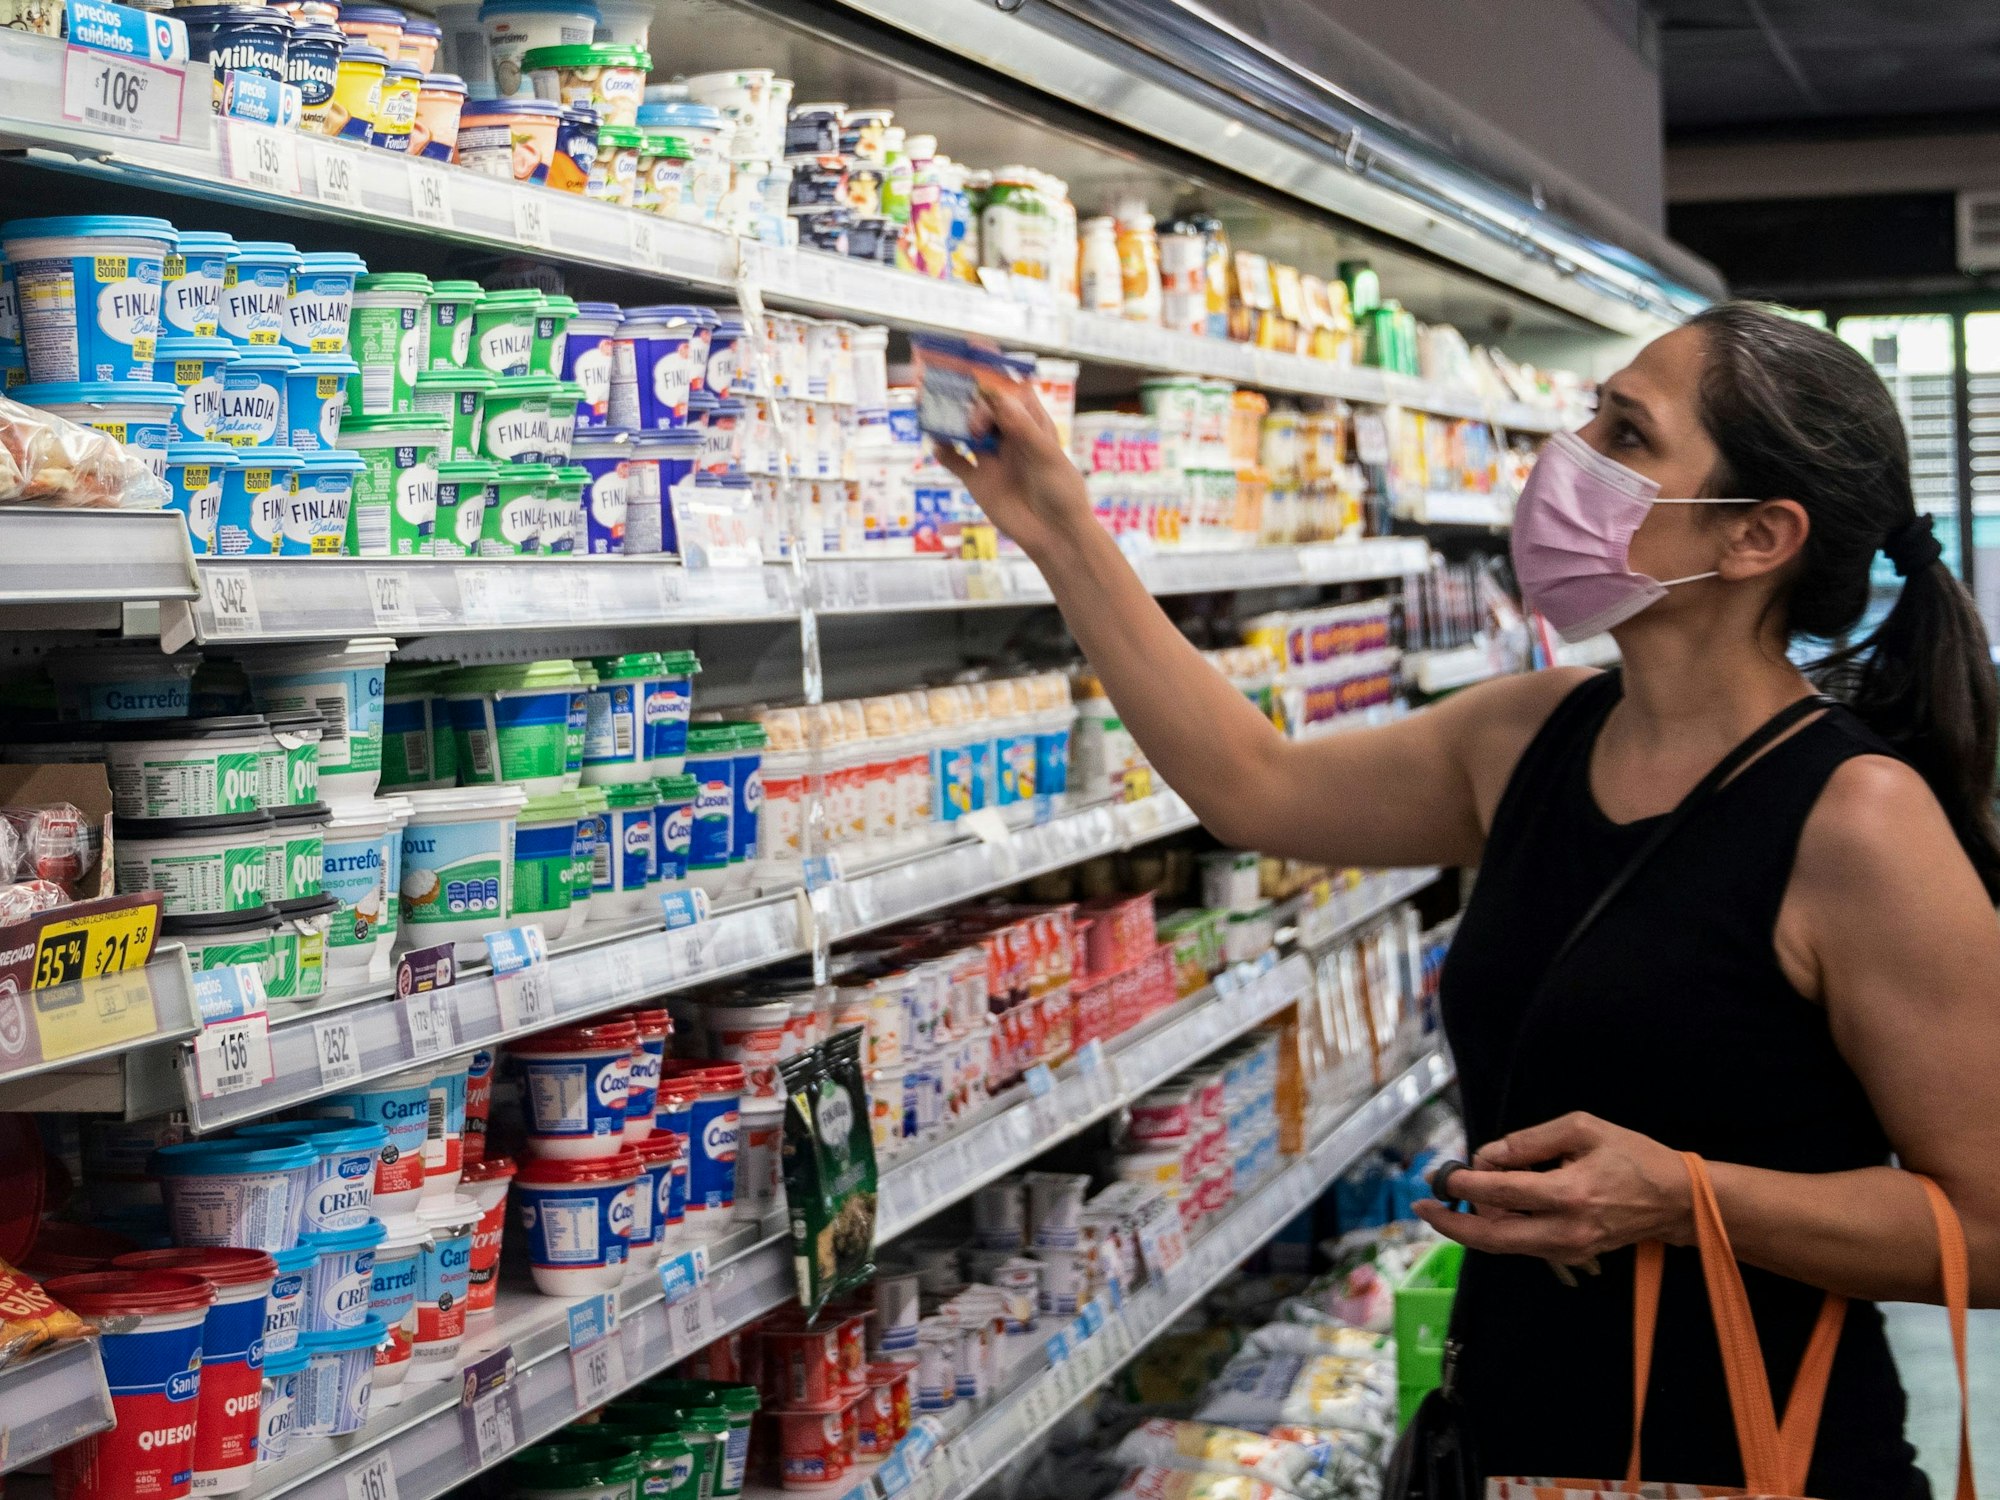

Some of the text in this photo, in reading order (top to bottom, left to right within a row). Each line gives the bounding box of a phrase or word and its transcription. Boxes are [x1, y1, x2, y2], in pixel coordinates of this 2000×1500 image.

[75, 2, 121, 27] precios
[77, 22, 133, 53] cuidados
[239, 80, 267, 99] precios
[97, 258, 126, 267] BAJO EN
[98, 267, 126, 279] SODIO
[177, 364, 202, 372] BAJO EN
[176, 371, 201, 382] SODIO
[317, 386, 337, 395] SODIO
[397, 447, 415, 458] 42%
[186, 469, 199, 477] BAJO
[186, 476, 208, 487] SODIO
[247, 479, 270, 490] SODIO
[440, 485, 456, 496] 42%
[215, 577, 248, 614] 342
[133, 925, 148, 945] 58
[37, 940, 81, 989] 35%
[322, 1026, 350, 1065] 252
[392, 1179, 412, 1190] 320g
[138, 1426, 191, 1451] QUESO
[135, 1474, 158, 1485] 480g
